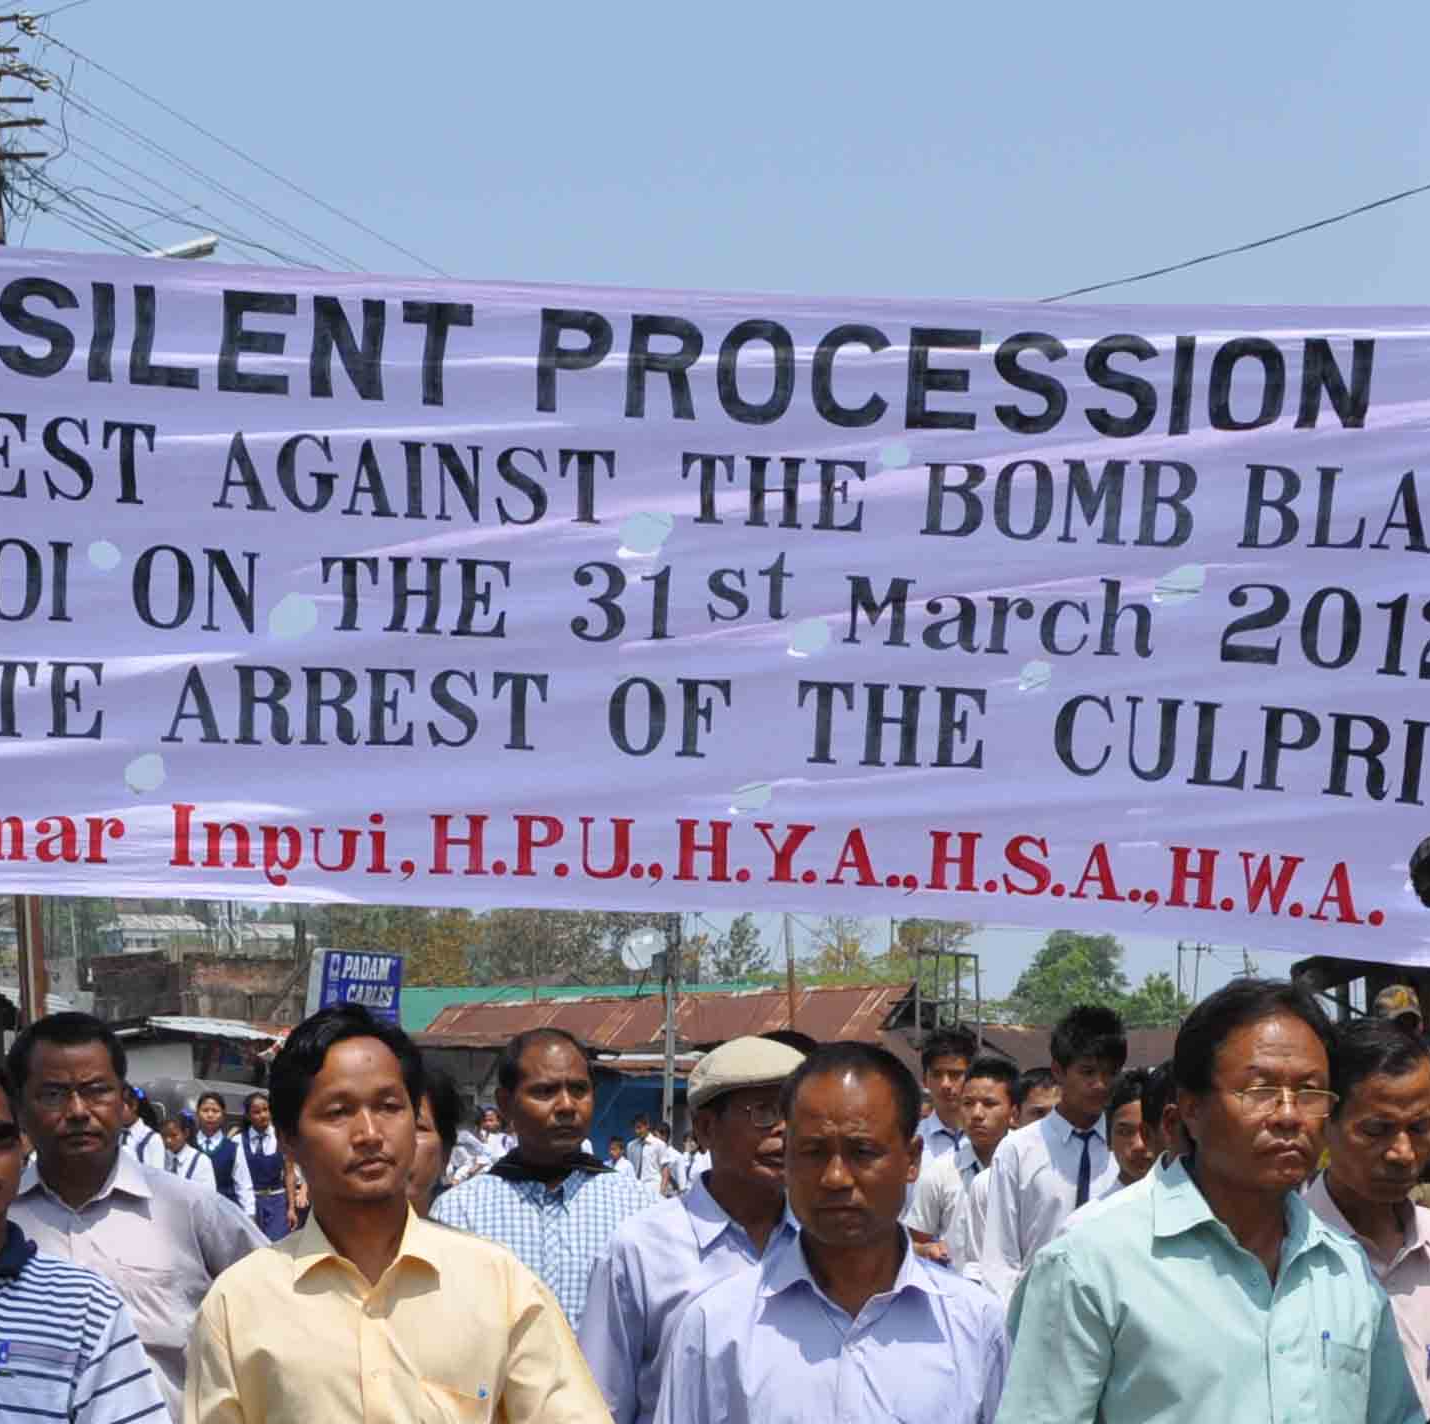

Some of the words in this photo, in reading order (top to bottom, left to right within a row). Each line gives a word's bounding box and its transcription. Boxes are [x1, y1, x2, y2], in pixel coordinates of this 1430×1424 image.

[536, 307, 1375, 439] PROCESSION
[212, 430, 615, 526] AGAINST
[681, 452, 865, 533] THE
[921, 460, 1197, 548] BOMB
[132, 545, 258, 634] ON
[321, 556, 510, 640] THE
[842, 574, 1153, 659] March
[162, 665, 548, 752] ARREST
[609, 676, 732, 758] OF
[798, 680, 986, 770] THE
[341, 954, 391, 981] PADAM
